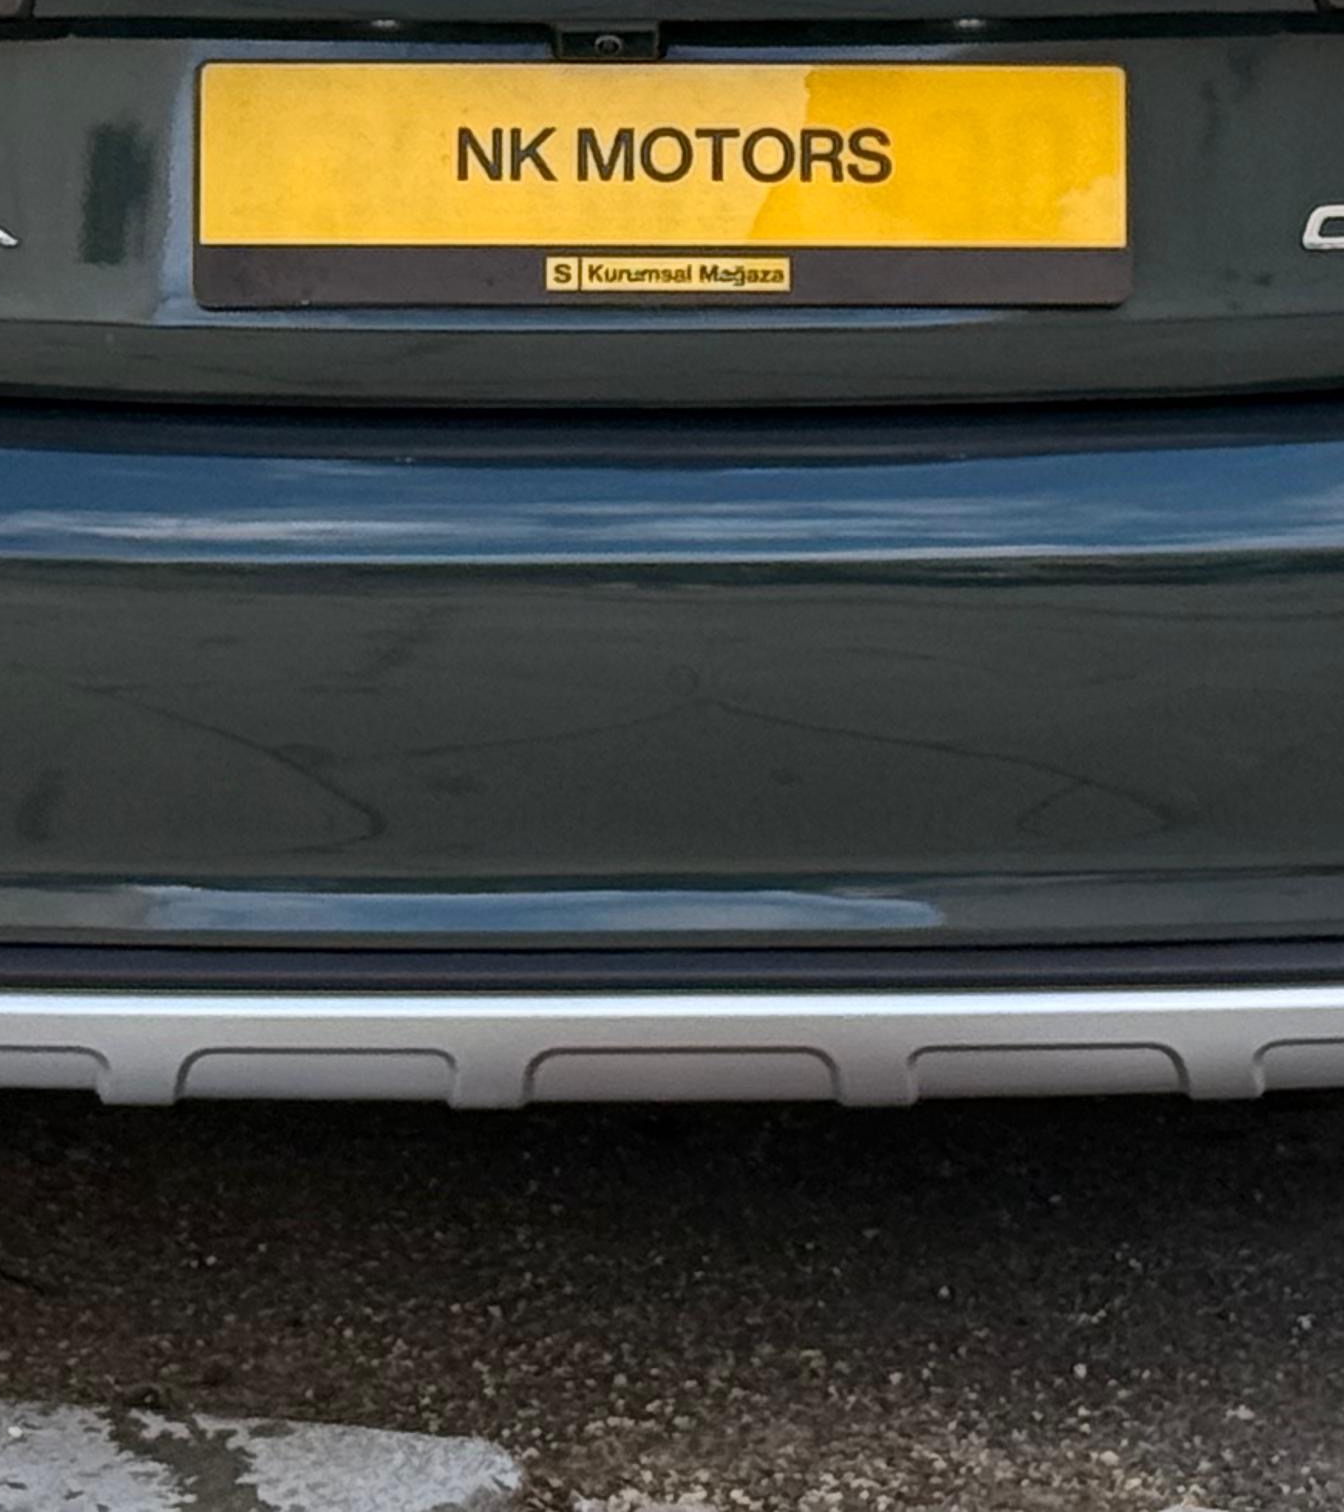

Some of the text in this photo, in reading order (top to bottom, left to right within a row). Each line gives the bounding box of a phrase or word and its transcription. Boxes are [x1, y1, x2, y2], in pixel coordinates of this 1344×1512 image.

[456, 126, 893, 184] NK MOTORS
[552, 262, 574, 285] S
[587, 262, 693, 284] Kurumsal
